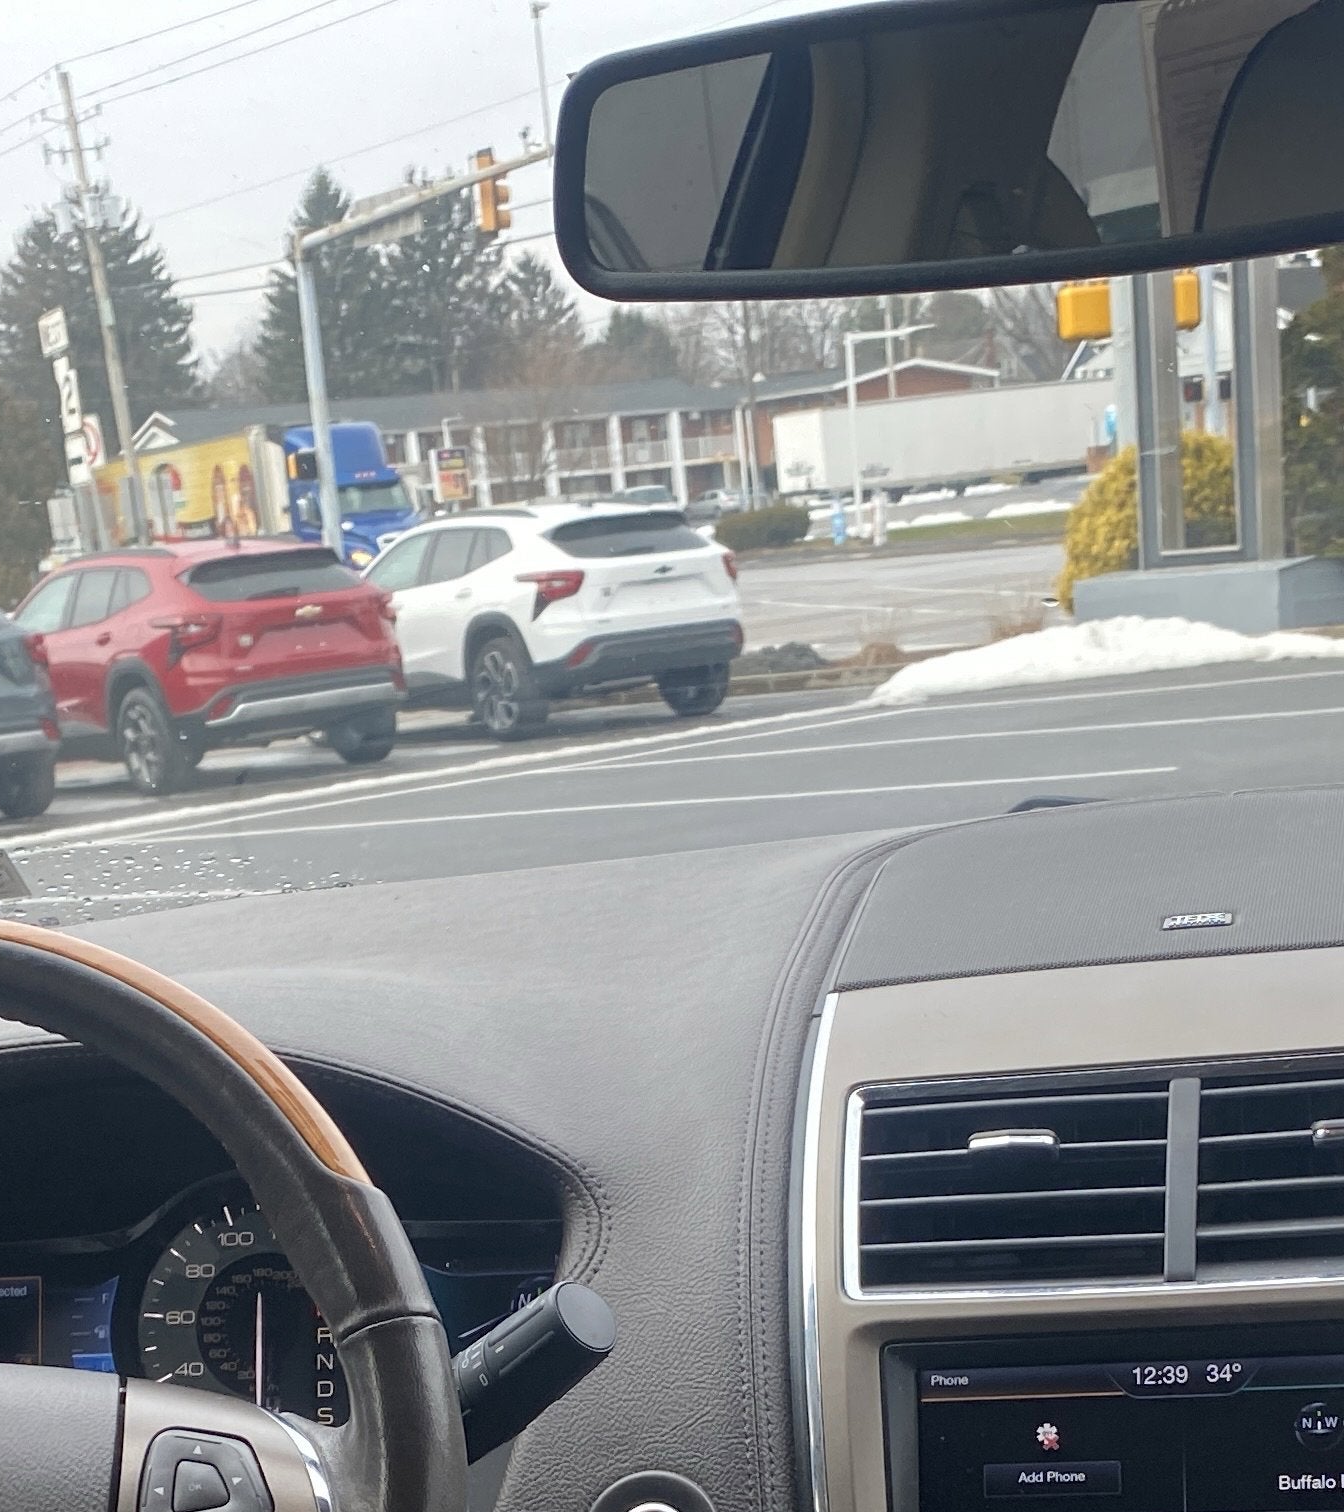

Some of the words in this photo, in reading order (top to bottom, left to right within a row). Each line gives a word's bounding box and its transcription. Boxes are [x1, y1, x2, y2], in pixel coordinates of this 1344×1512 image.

[218, 1232, 254, 1247] 100
[186, 1264, 215, 1278] 80
[165, 1311, 195, 1325] 60
[175, 1362, 204, 1377] 40
[317, 1354, 333, 1370] N
[931, 1375, 969, 1386] Phone
[1132, 1365, 1189, 1385] 12:39
[1206, 1363, 1242, 1382] 34°
[317, 1381, 333, 1397] D
[317, 1408, 333, 1425] S
[1018, 1471, 1043, 1483] Add
[1047, 1470, 1086, 1483] Phone
[1278, 1475, 1336, 1490] Buffalo
